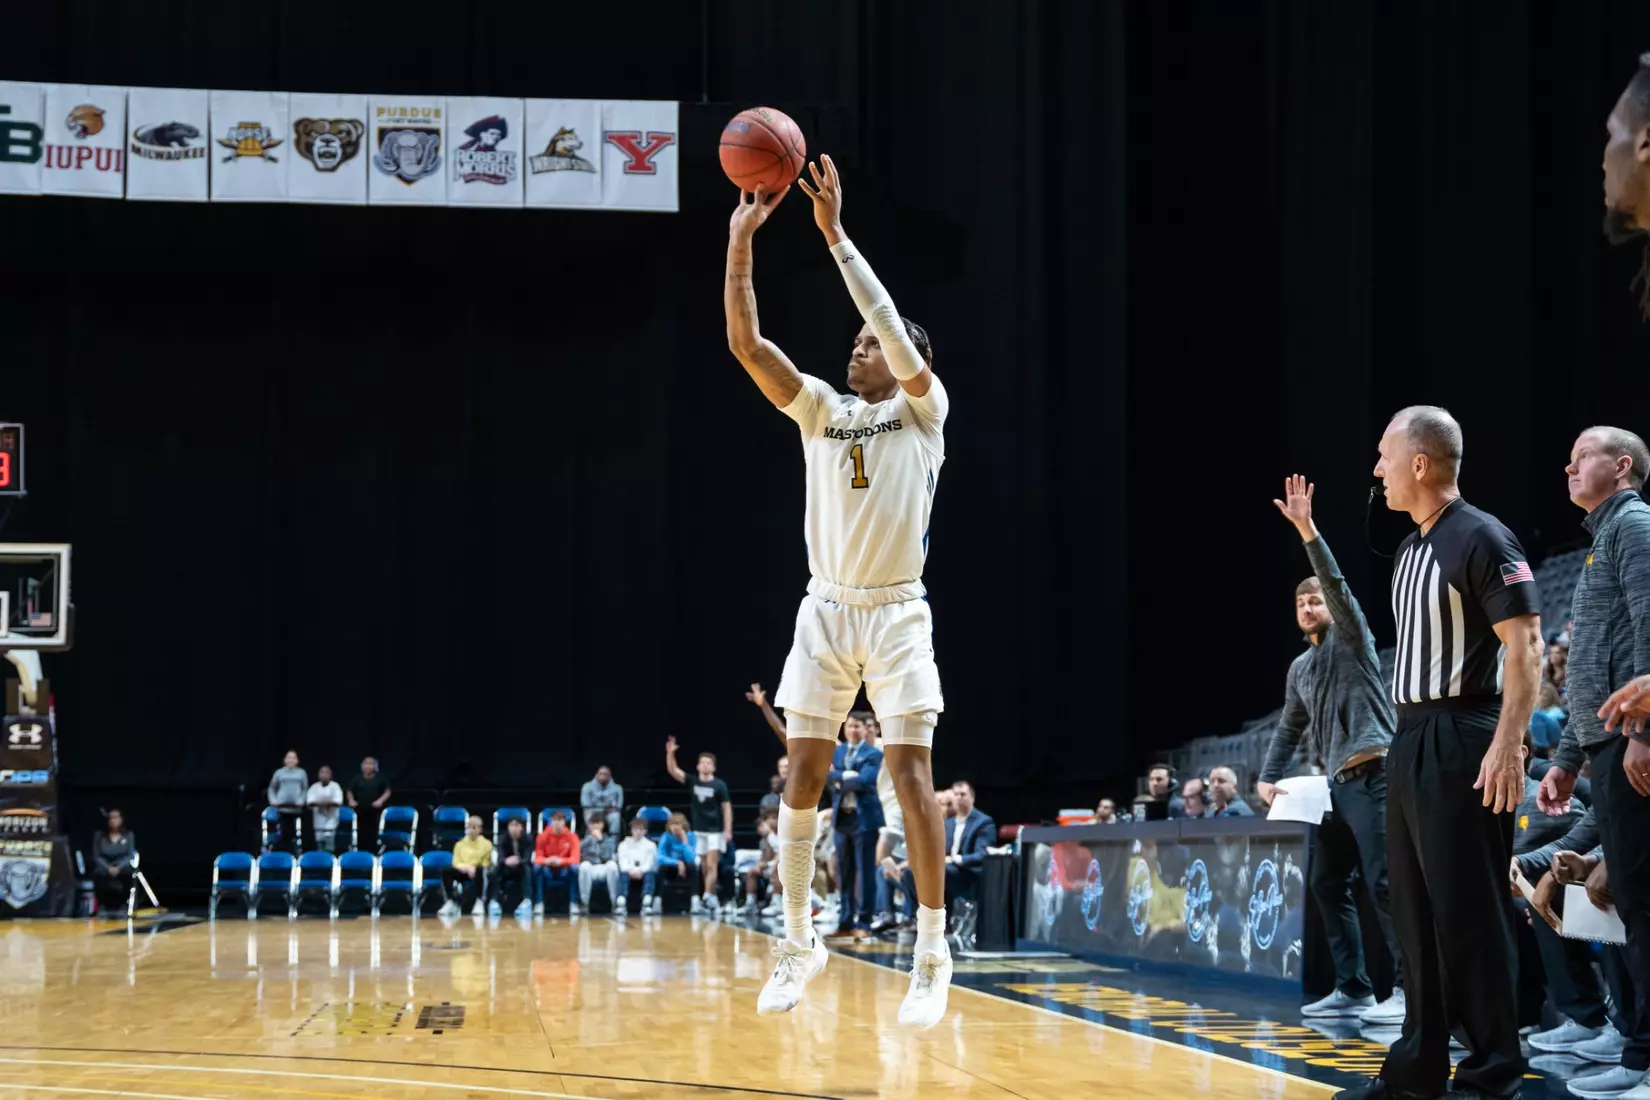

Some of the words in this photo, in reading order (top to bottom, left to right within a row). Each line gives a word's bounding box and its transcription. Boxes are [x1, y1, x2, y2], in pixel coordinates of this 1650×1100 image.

[376, 106, 442, 118] PURDUE
[44, 143, 124, 172] IUPUI
[131, 143, 205, 160] MILWAUKEE
[455, 150, 517, 163] ROBERT
[604, 131, 675, 175] Y
[823, 418, 903, 441] MASTODONS
[850, 443, 869, 489] 1
